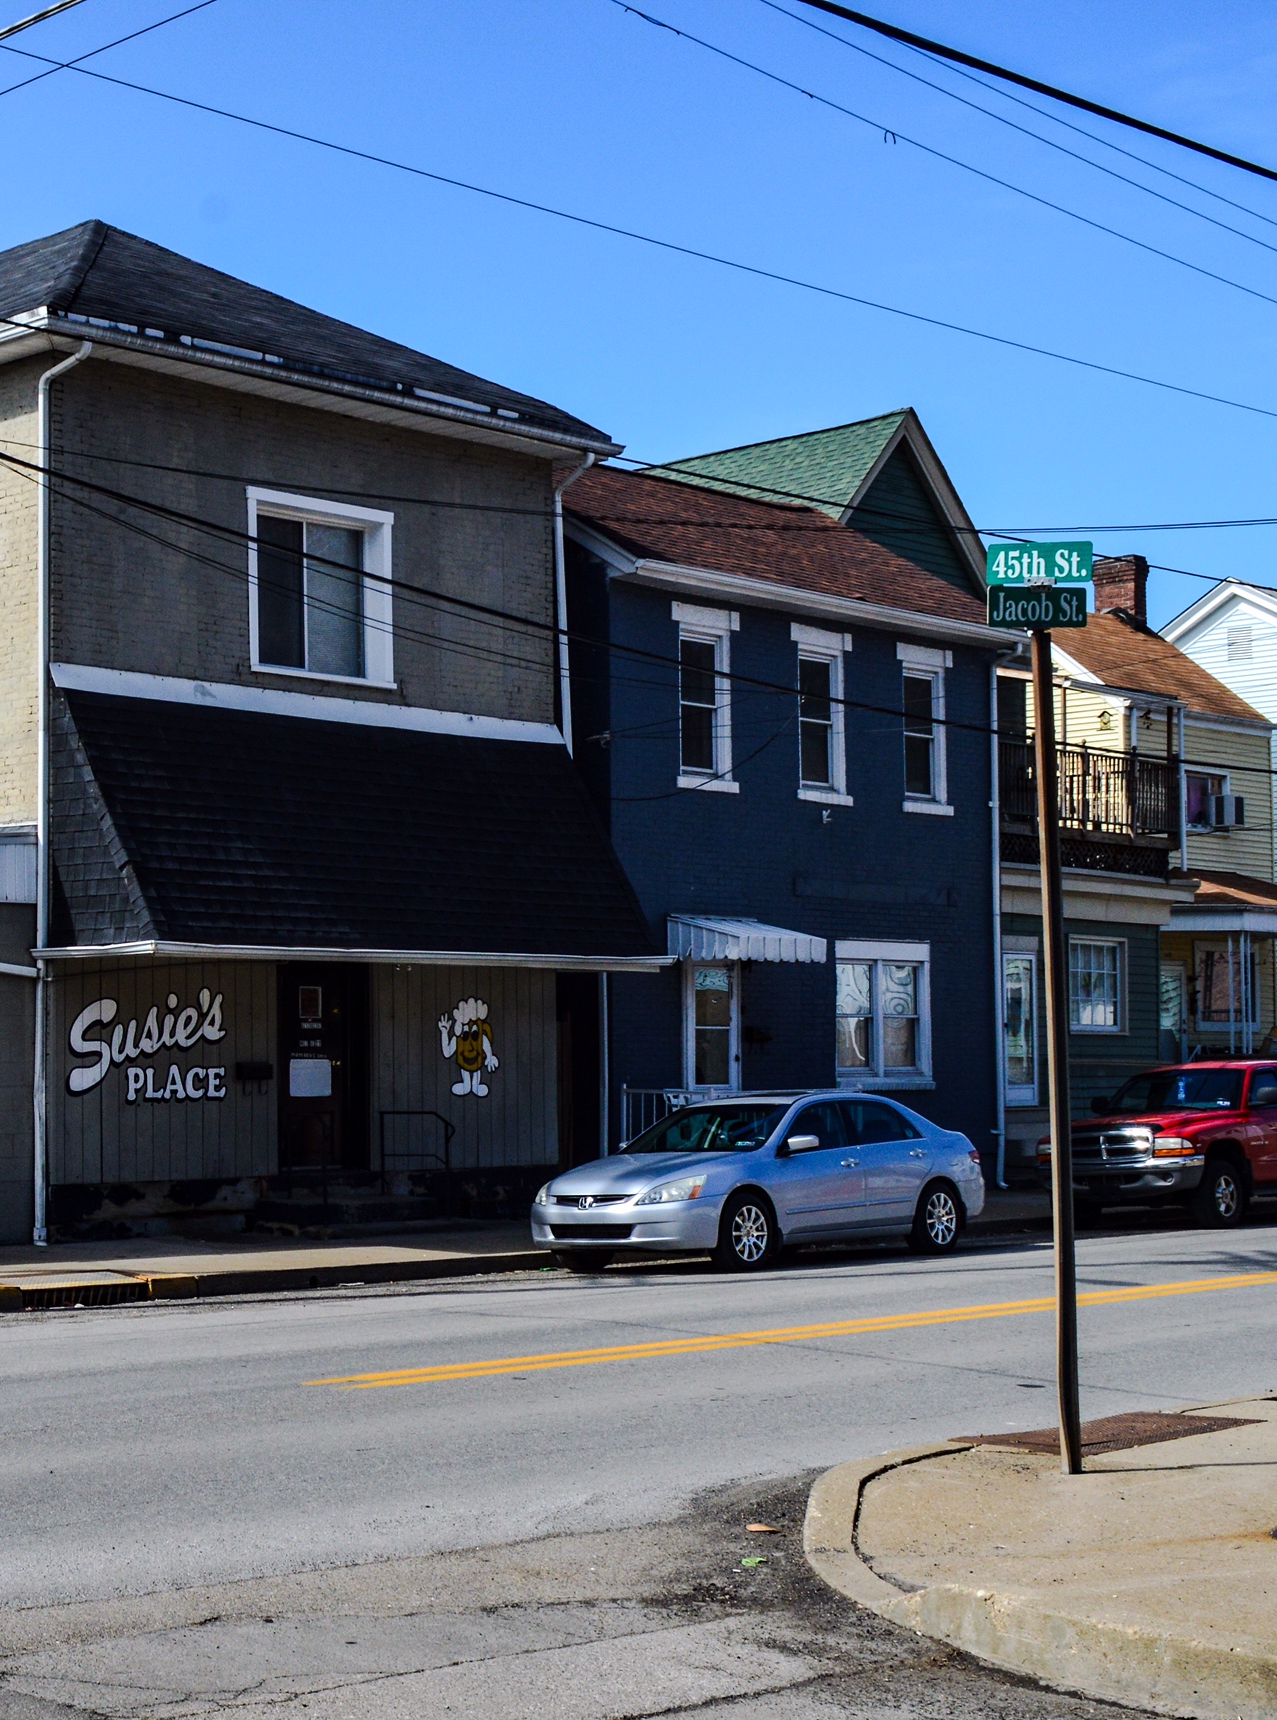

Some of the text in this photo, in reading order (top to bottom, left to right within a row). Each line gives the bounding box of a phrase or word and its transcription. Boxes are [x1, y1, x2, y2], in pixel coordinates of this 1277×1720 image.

[992, 549, 1087, 578] 45th St.
[993, 592, 1083, 621] Jacob St.
[68, 987, 226, 1092] Susie's
[126, 1065, 226, 1102] PLACE
